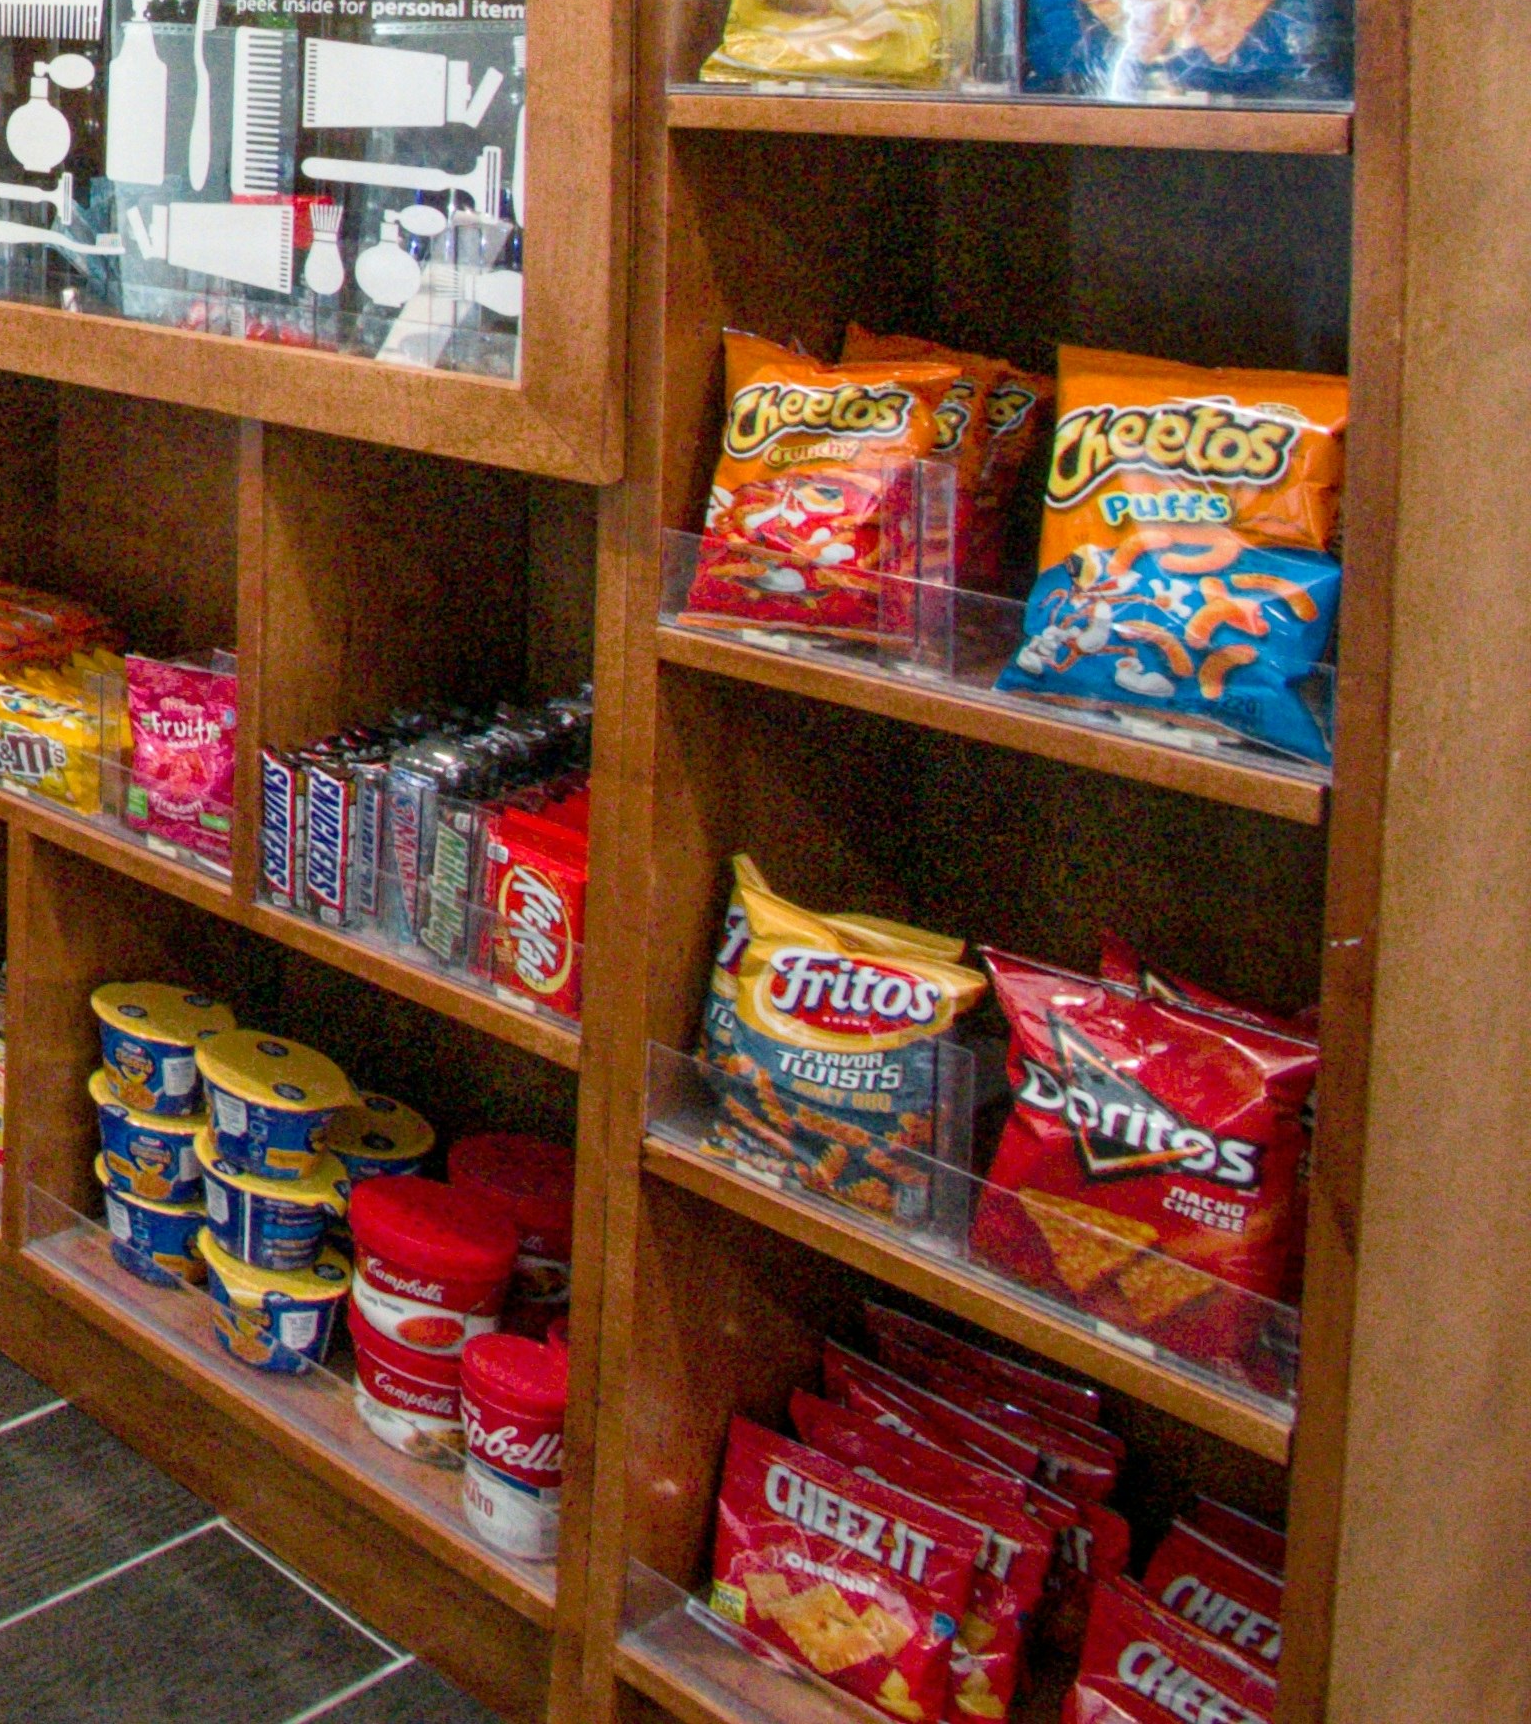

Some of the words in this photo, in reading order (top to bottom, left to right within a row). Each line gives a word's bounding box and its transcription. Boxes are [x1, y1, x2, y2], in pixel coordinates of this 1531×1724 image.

[728, 385, 911, 454] Cheetos
[764, 439, 861, 467] Crunchy
[1049, 406, 1298, 506] Cheetos
[1103, 491, 1231, 525] Puffs
[263, 757, 290, 891] SNICKERS
[308, 767, 341, 905] SNICKERS
[770, 947, 941, 1024] Fritos
[777, 1050, 902, 1091] TWISTS
[801, 1049, 885, 1070] FLAVOR
[1020, 1059, 1257, 1184] Doritos
[1162, 1196, 1245, 1234] CHEESE
[1170, 1186, 1246, 1219] NACHO
